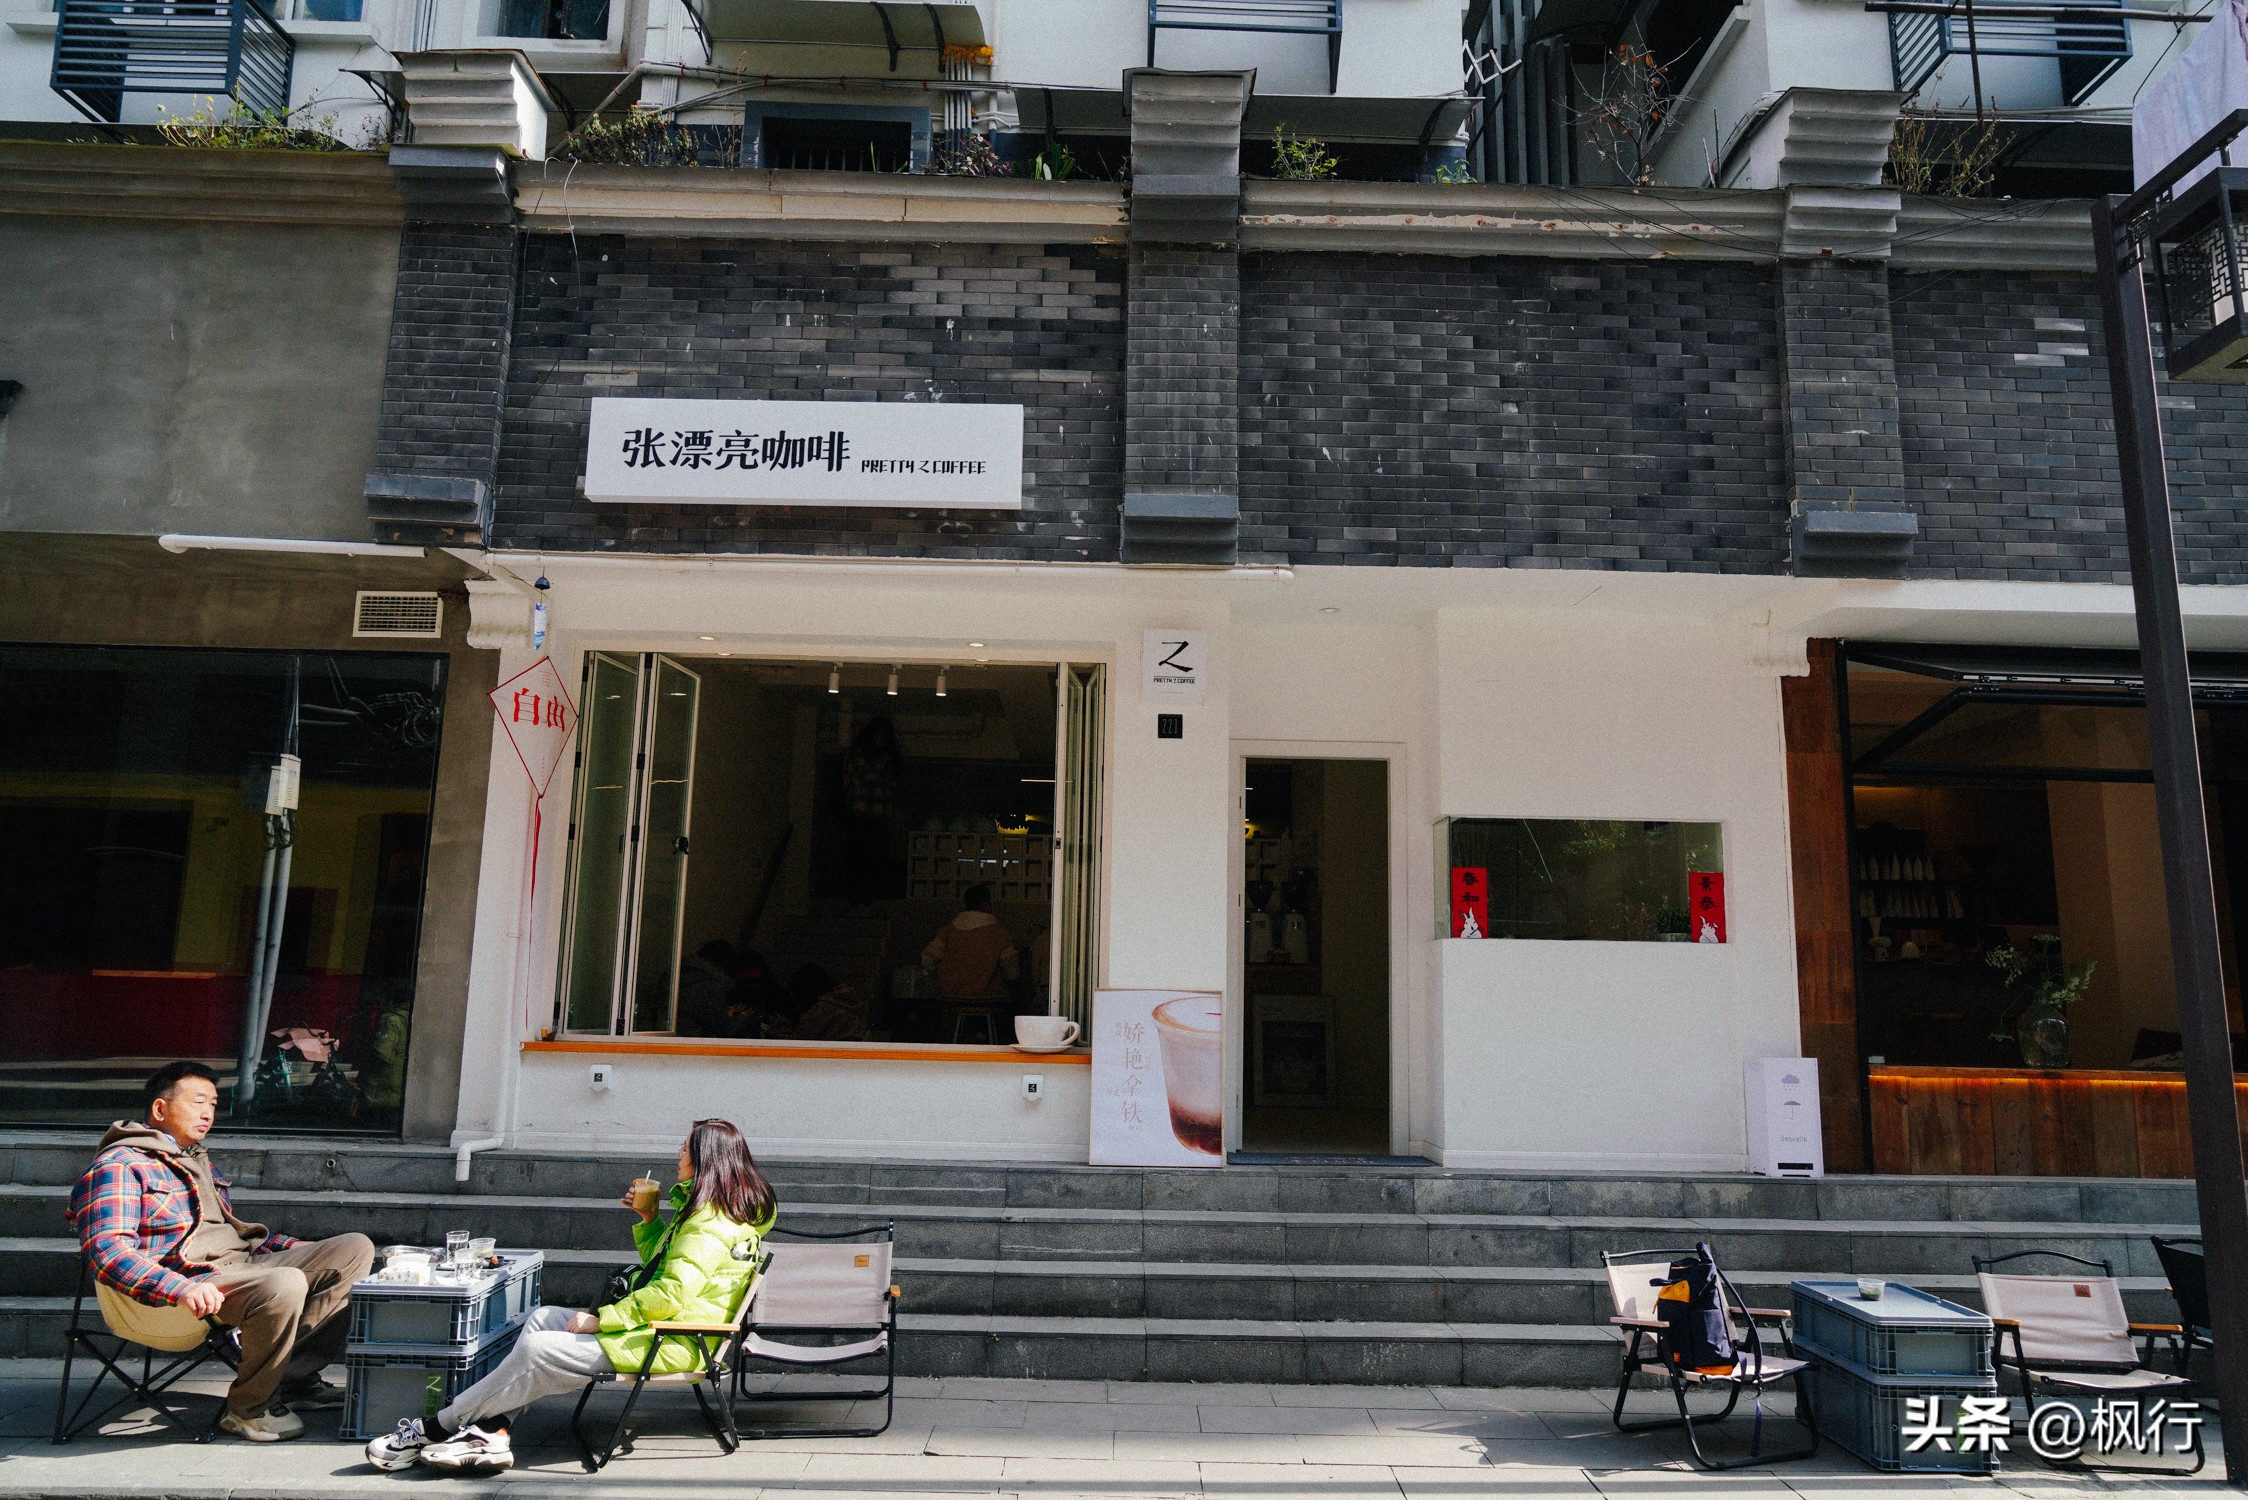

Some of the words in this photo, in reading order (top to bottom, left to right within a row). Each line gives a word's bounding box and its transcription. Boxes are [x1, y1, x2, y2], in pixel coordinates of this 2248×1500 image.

[622, 427, 851, 472] 张漂亮咖啡
[860, 459, 915, 474] PRETTY
[932, 460, 987, 475] COFFEE
[513, 687, 566, 732] 自由
[1162, 718, 1178, 734] 221
[1460, 871, 1480, 906] 春和
[1121, 1021, 1145, 1124] 娇艳拿铁
